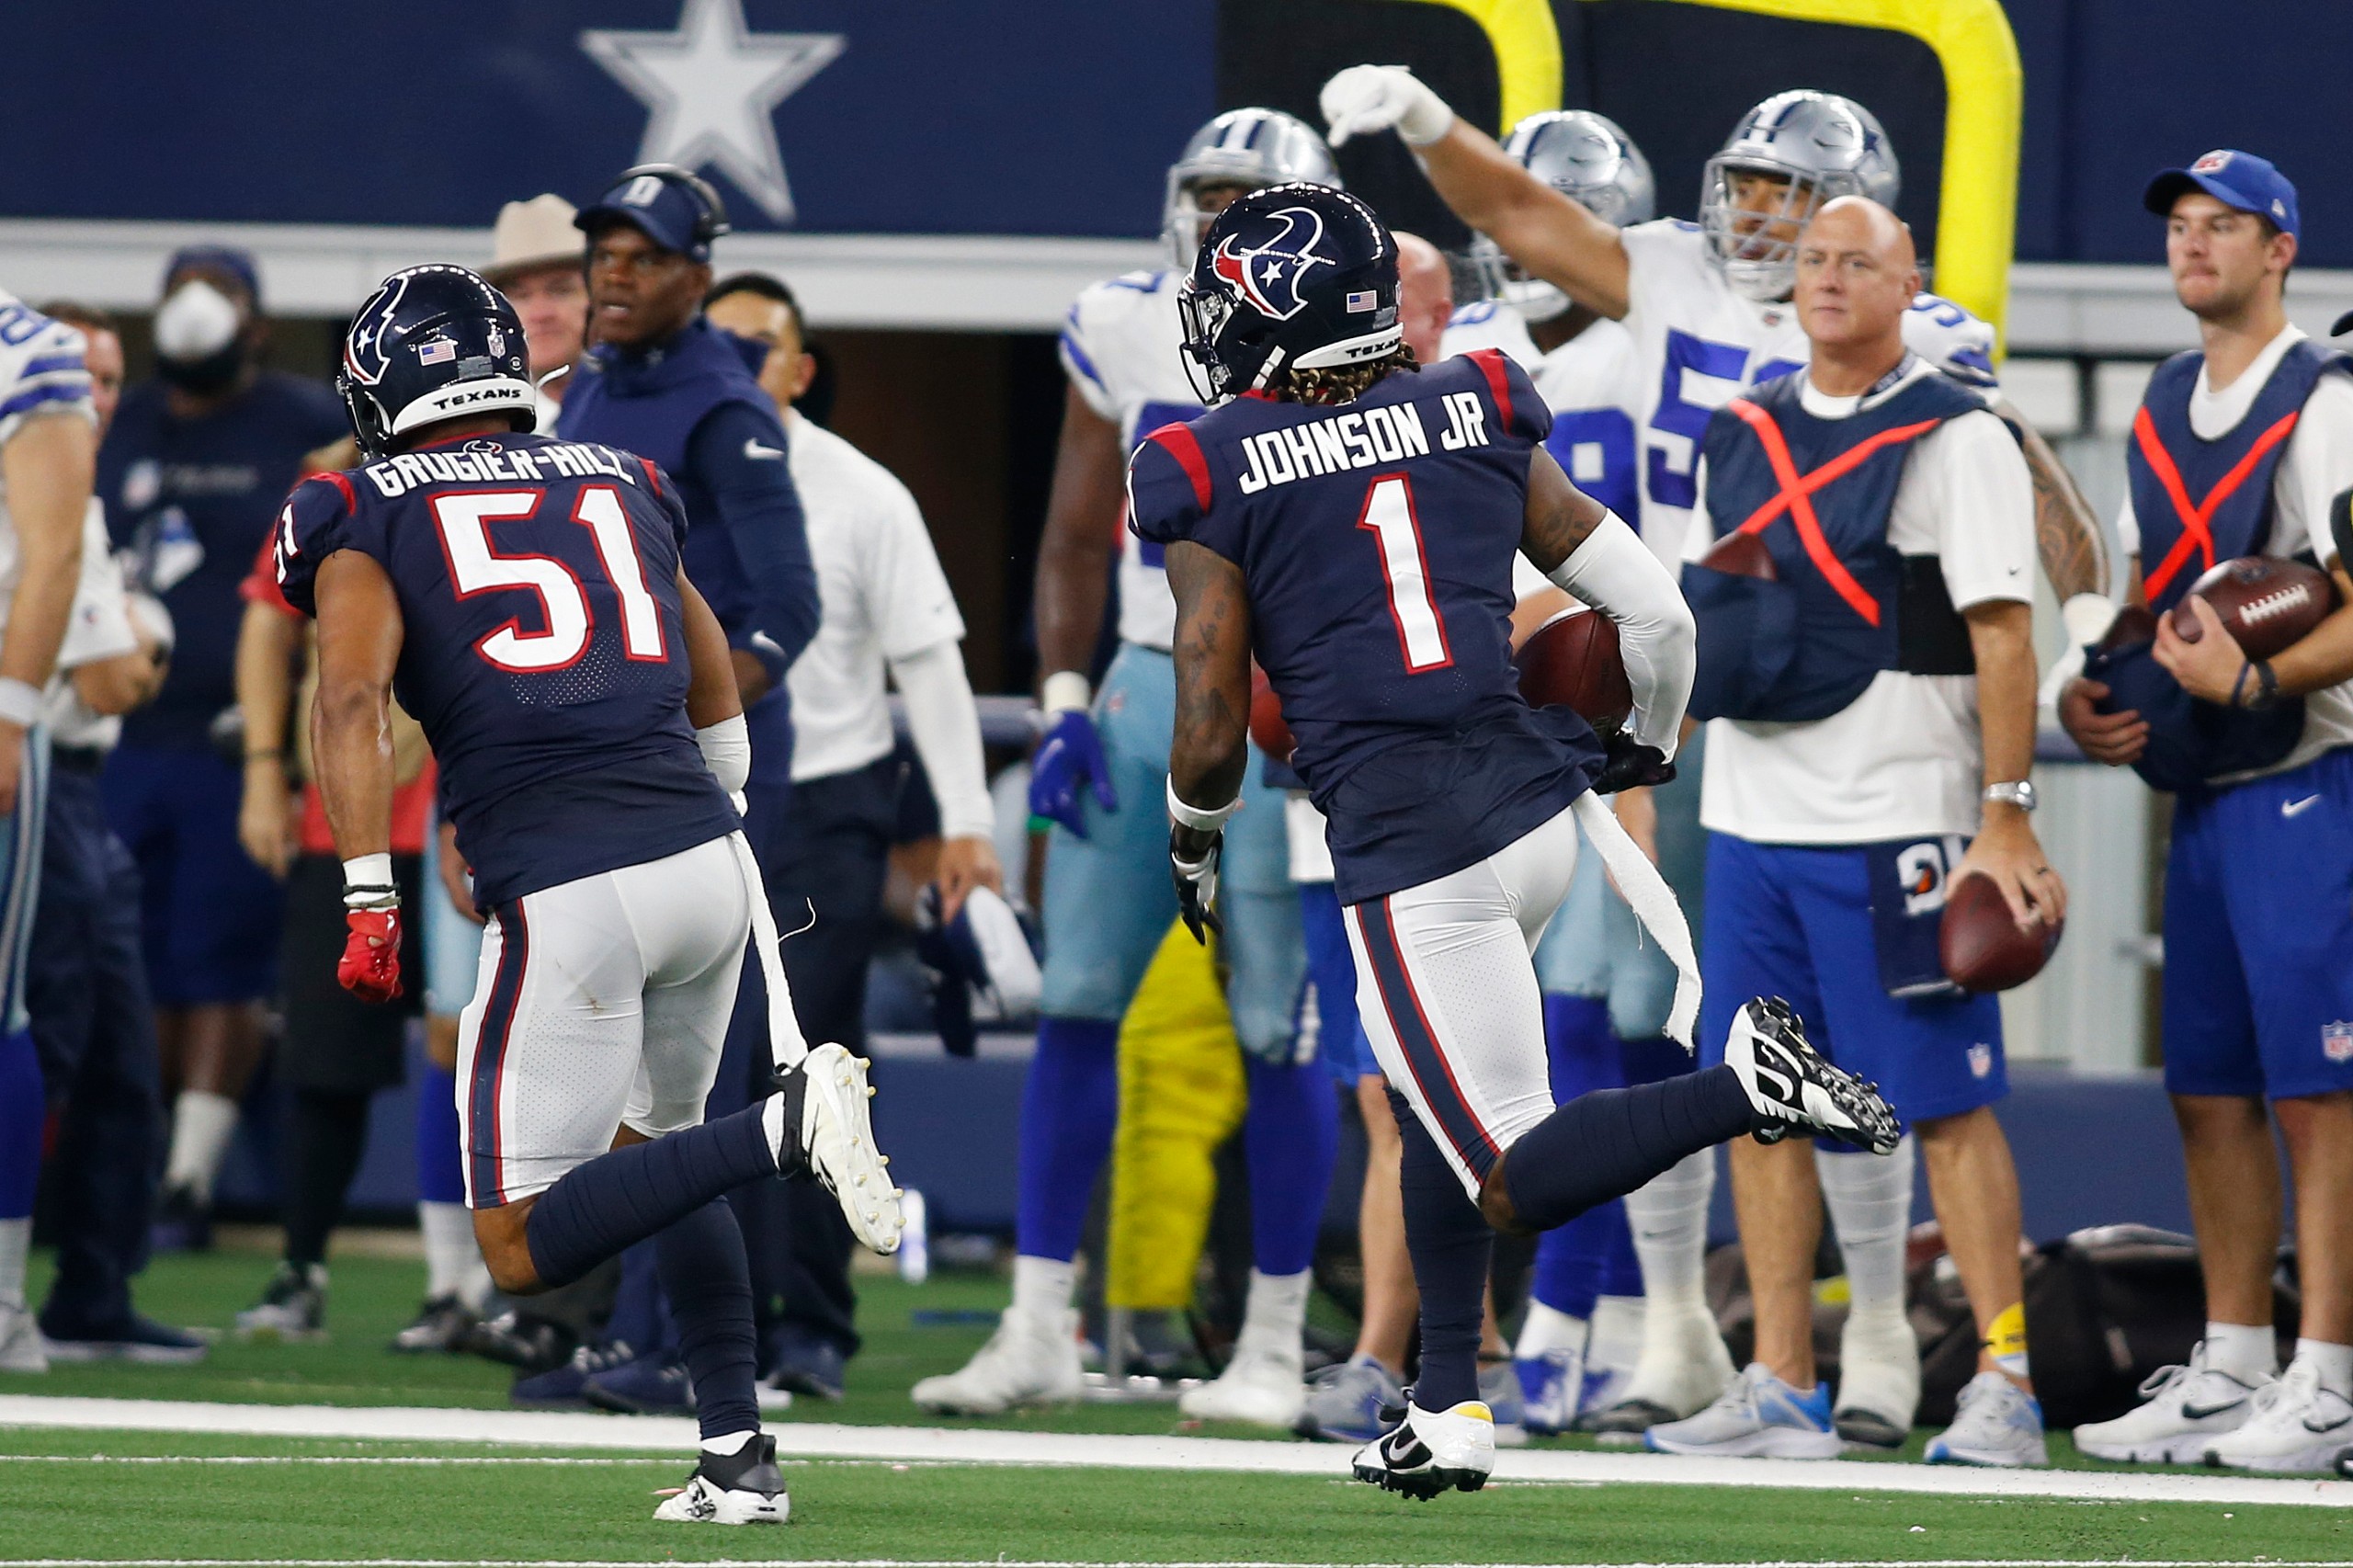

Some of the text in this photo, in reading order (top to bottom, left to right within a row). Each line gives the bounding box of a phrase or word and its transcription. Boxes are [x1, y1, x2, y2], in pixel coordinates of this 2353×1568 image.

[433, 388, 521, 410] TEXANS
[1239, 402, 1430, 494] JOHNSON
[1440, 392, 1490, 450] JR
[366, 442, 634, 497] GRUGIER-HILL
[426, 483, 668, 673] 51
[1356, 471, 1454, 675] 1
